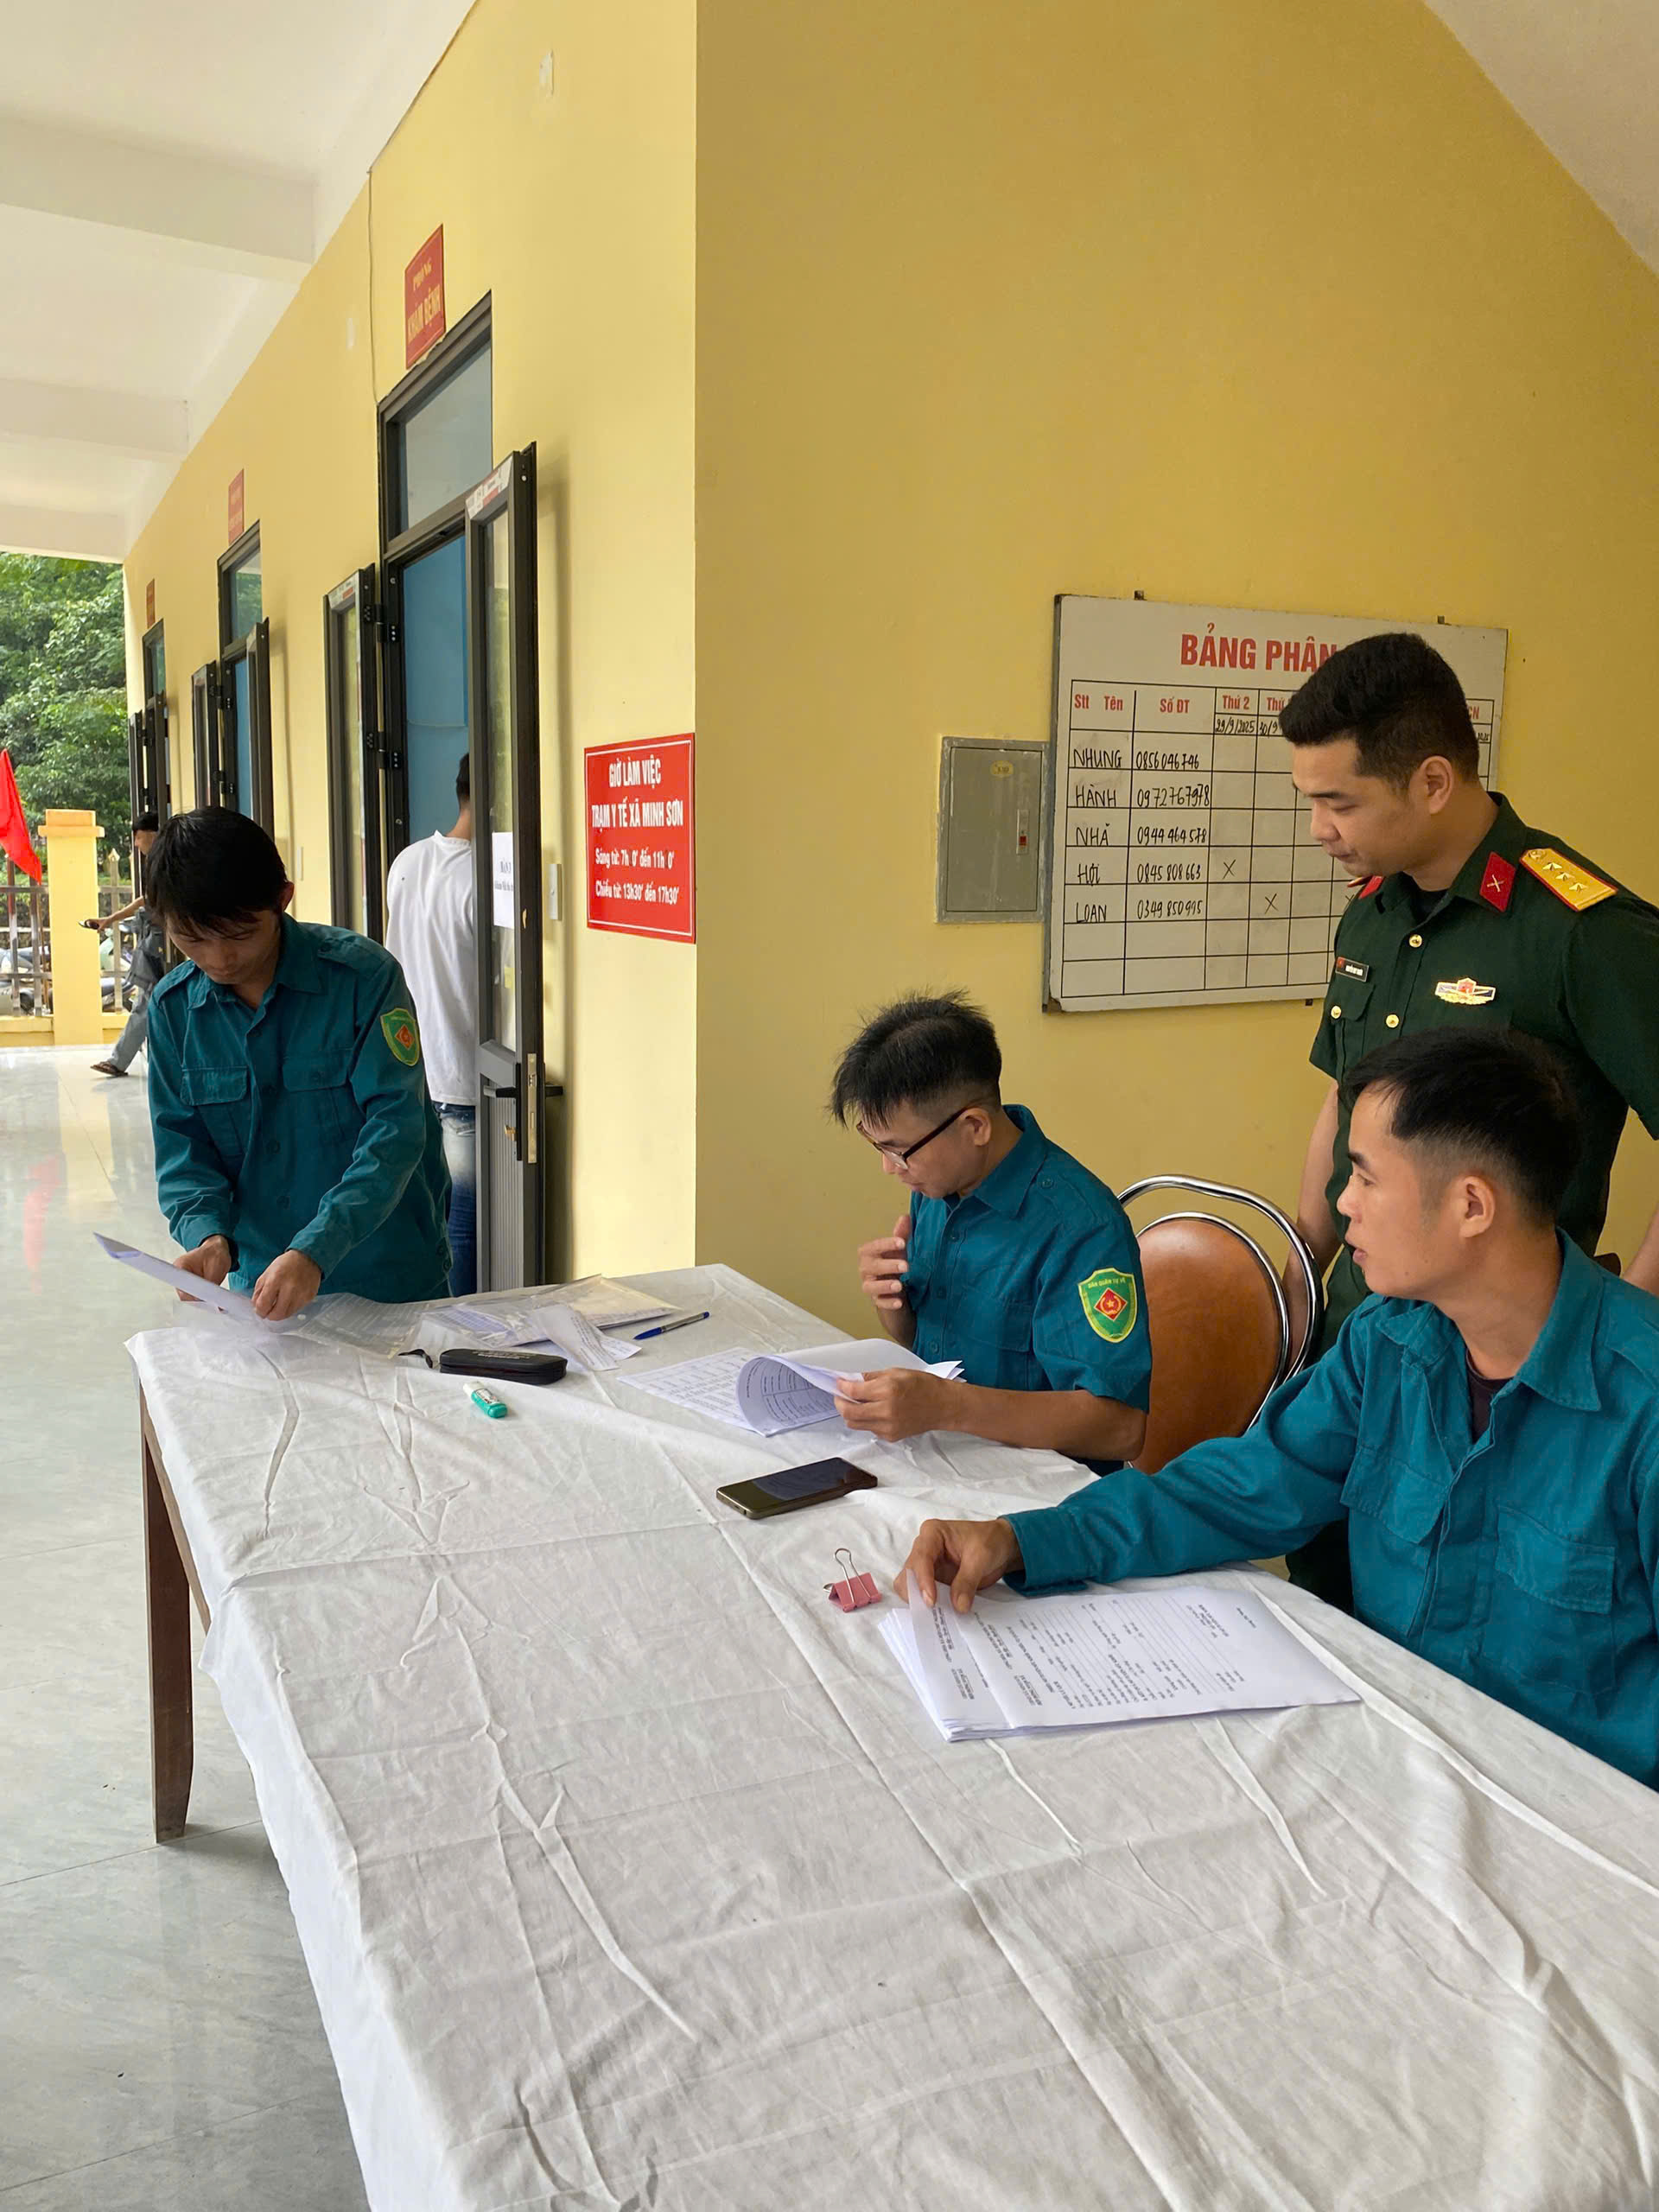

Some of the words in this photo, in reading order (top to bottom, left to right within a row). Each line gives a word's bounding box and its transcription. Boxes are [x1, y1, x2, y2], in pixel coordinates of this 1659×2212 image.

[1181, 622, 1256, 670] BẢNG
[1074, 694, 1090, 709] Stt
[1104, 696, 1123, 711] Tên
[1160, 696, 1174, 713] Số
[1176, 699, 1190, 714] ĐT
[1223, 694, 1240, 709] Thứ
[1243, 696, 1249, 709] 2
[1073, 748, 1122, 768] NHUNG
[609, 758, 621, 787] GIỜ
[623, 756, 640, 786] LÀM
[642, 754, 661, 789] VIỆC
[1075, 784, 1116, 807] HÀNH
[592, 804, 610, 832] TRẠM
[611, 804, 616, 828] Y
[618, 796, 627, 827] TẾ
[629, 798, 641, 827] XÃ
[642, 802, 664, 827] MINH
[666, 798, 683, 827] SƠN
[595, 847, 610, 868] Sáng
[639, 847, 652, 868] đến
[595, 879, 612, 898] Chiều
[645, 880, 656, 902] đến
[1076, 902, 1107, 923] LOAN
